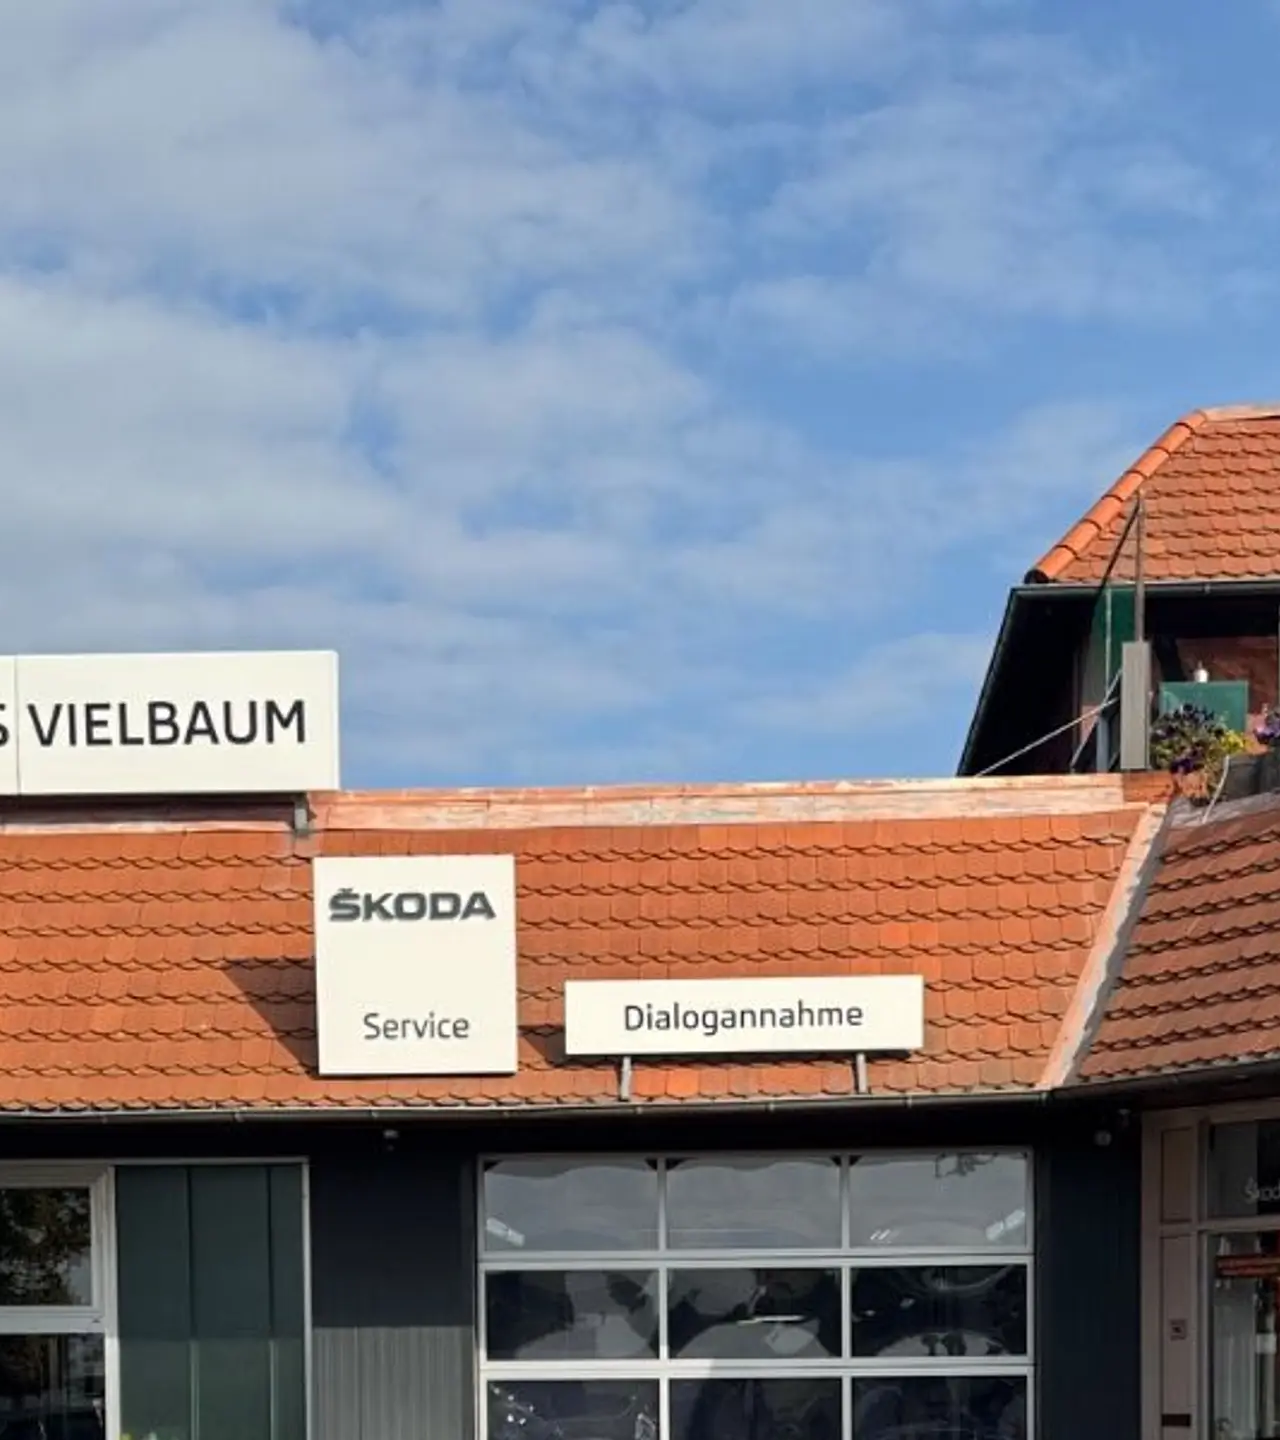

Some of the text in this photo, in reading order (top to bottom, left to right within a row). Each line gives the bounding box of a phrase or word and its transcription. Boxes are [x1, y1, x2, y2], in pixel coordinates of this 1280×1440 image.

[27, 699, 306, 747] VIELBAUM
[328, 888, 496, 921] ŠKODA
[362, 1012, 470, 1040] Service
[623, 1000, 864, 1036] Dialogannahme
